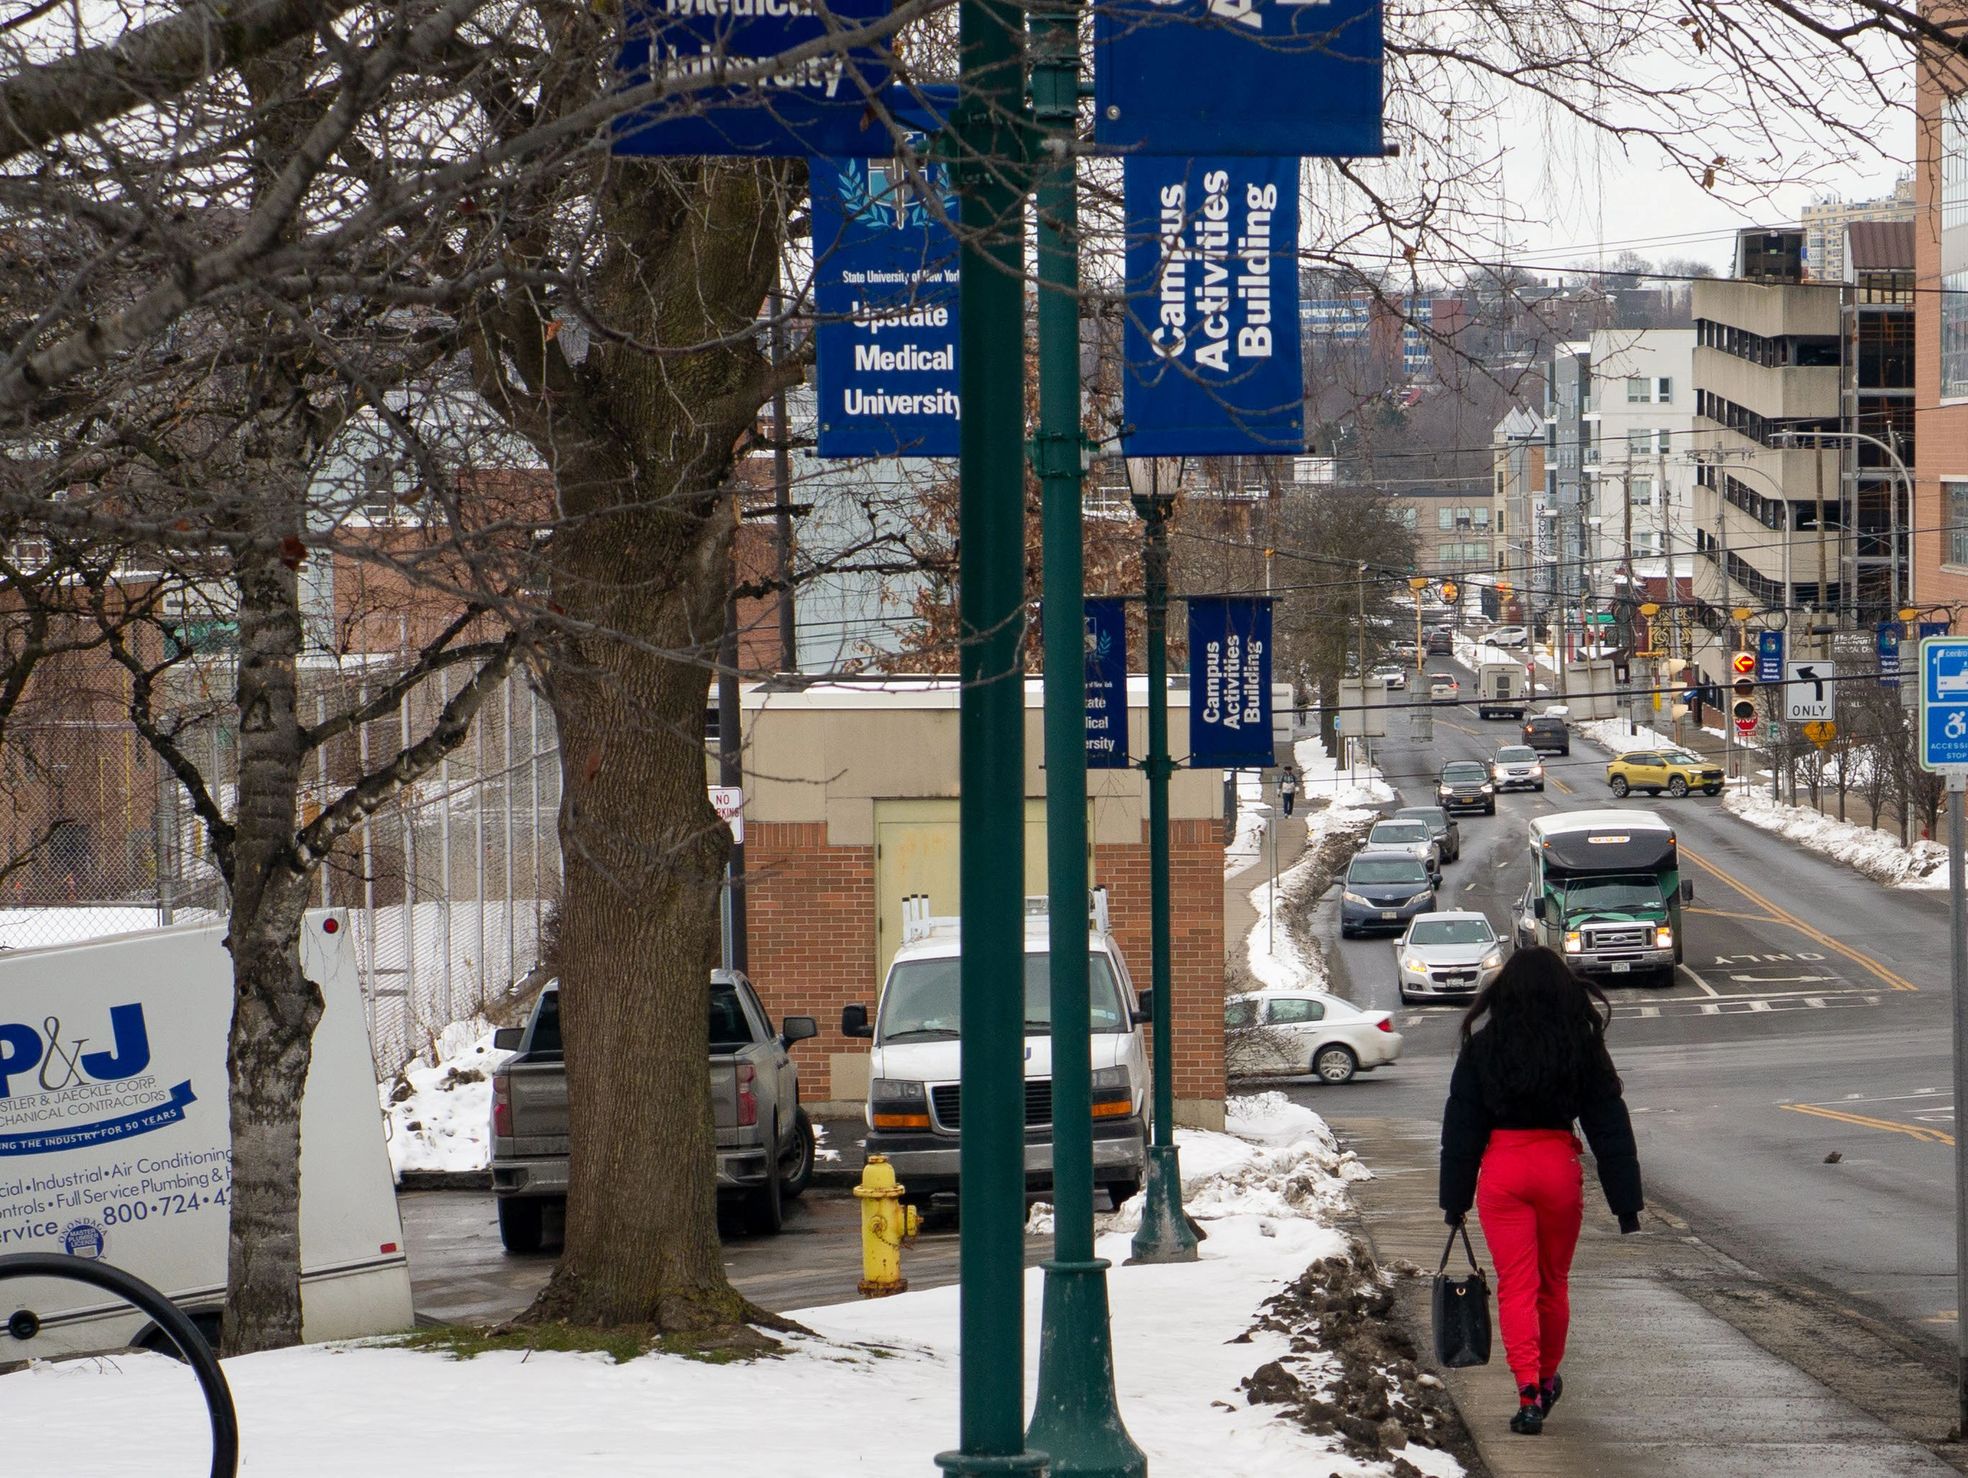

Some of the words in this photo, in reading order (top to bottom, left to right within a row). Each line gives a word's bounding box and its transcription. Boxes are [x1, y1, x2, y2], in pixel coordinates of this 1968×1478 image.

[843, 270, 865, 283] State
[867, 269, 909, 285] University
[1152, 184, 1186, 358] Campus
[1195, 170, 1229, 372] Activities
[1238, 183, 1278, 357] Building
[852, 301, 948, 334] Upstate
[855, 344, 954, 371] Medical
[844, 388, 960, 420] University
[1203, 641, 1222, 723] Campus
[1223, 634, 1240, 730] Activities
[1243, 636, 1263, 723] Building
[1085, 697, 1107, 709] ate
[1792, 705, 1827, 717] ONLY
[1946, 752, 1968, 760] STOP
[716, 795, 730, 805] NO
[716, 807, 740, 818] RKING
[41, 1095, 52, 1106] &
[54, 1085, 113, 1103] JAECKLE
[116, 1077, 157, 1093] CORP.
[68, 1090, 166, 1116] CONTRACTORS
[20, 1138, 42, 1149] THE
[45, 1130, 98, 1147] INDUSTRY
[101, 1124, 123, 1138] FOR
[126, 1120, 139, 1132] 50
[142, 1109, 177, 1126] YEARS
[137, 1147, 231, 1174] Conditioning
[56, 1192, 82, 1209] Full
[84, 1184, 139, 1204] Service
[141, 1173, 209, 1195] Plumbing
[212, 1167, 223, 1183] &
